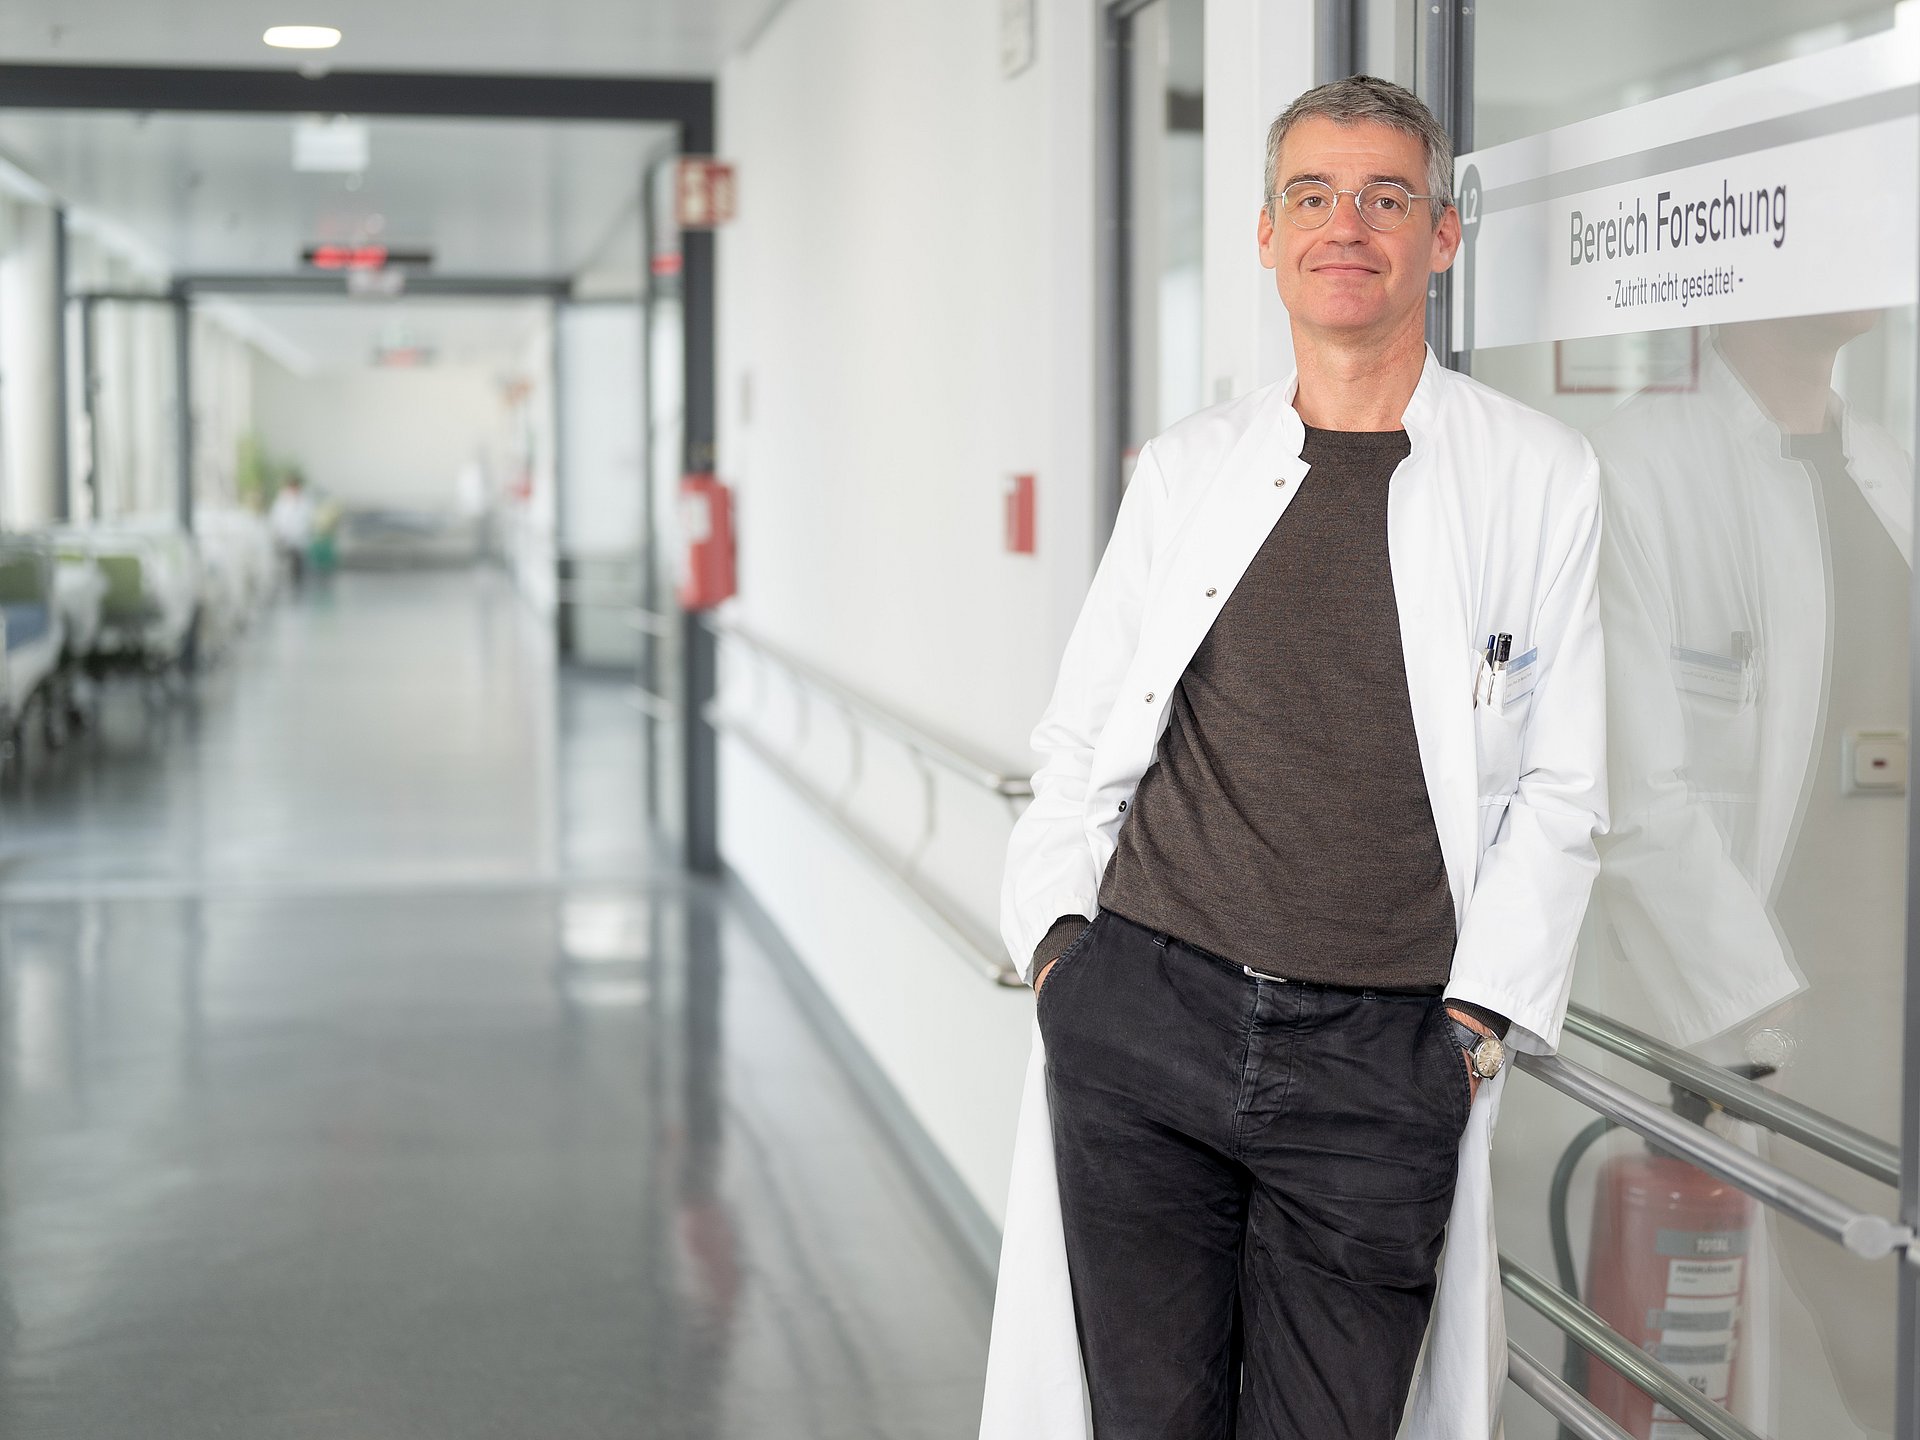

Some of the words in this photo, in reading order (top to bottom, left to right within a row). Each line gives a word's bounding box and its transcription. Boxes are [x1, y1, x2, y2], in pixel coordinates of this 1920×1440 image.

[1462, 187, 1478, 225] L2
[1570, 197, 1648, 266] Bereich
[1656, 178, 1787, 251] Forschung
[1614, 276, 1648, 309] Zutritt
[1650, 272, 1679, 304] nicht
[1681, 264, 1735, 308] gestattet
